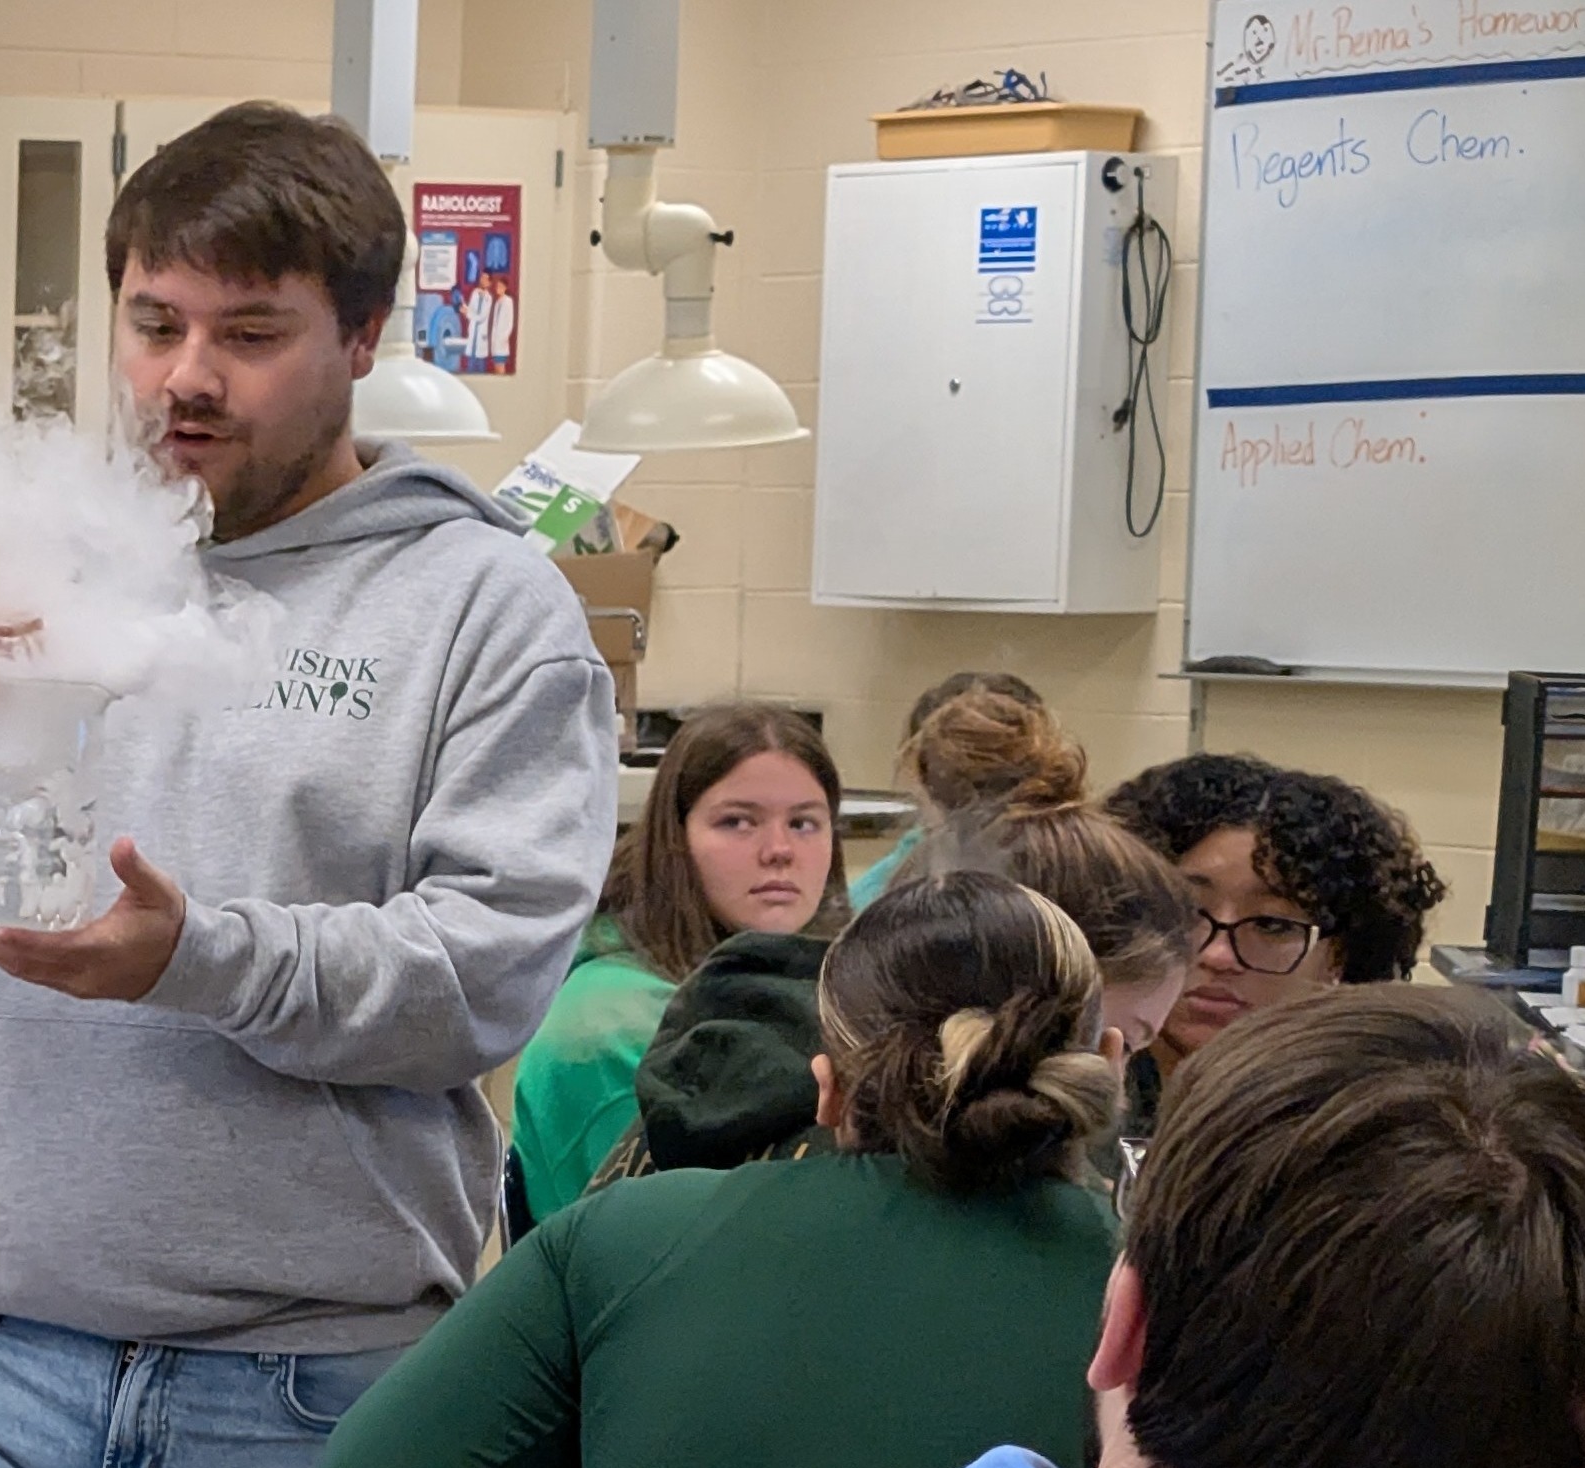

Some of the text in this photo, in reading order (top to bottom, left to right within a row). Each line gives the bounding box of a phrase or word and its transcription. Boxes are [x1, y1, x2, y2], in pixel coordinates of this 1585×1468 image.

[1232, 109, 1526, 208] Regents Chem.
[421, 194, 502, 213] RADIOLOGIST
[1221, 418, 1427, 487] Applied Chem.
[562, 497, 583, 513] S
